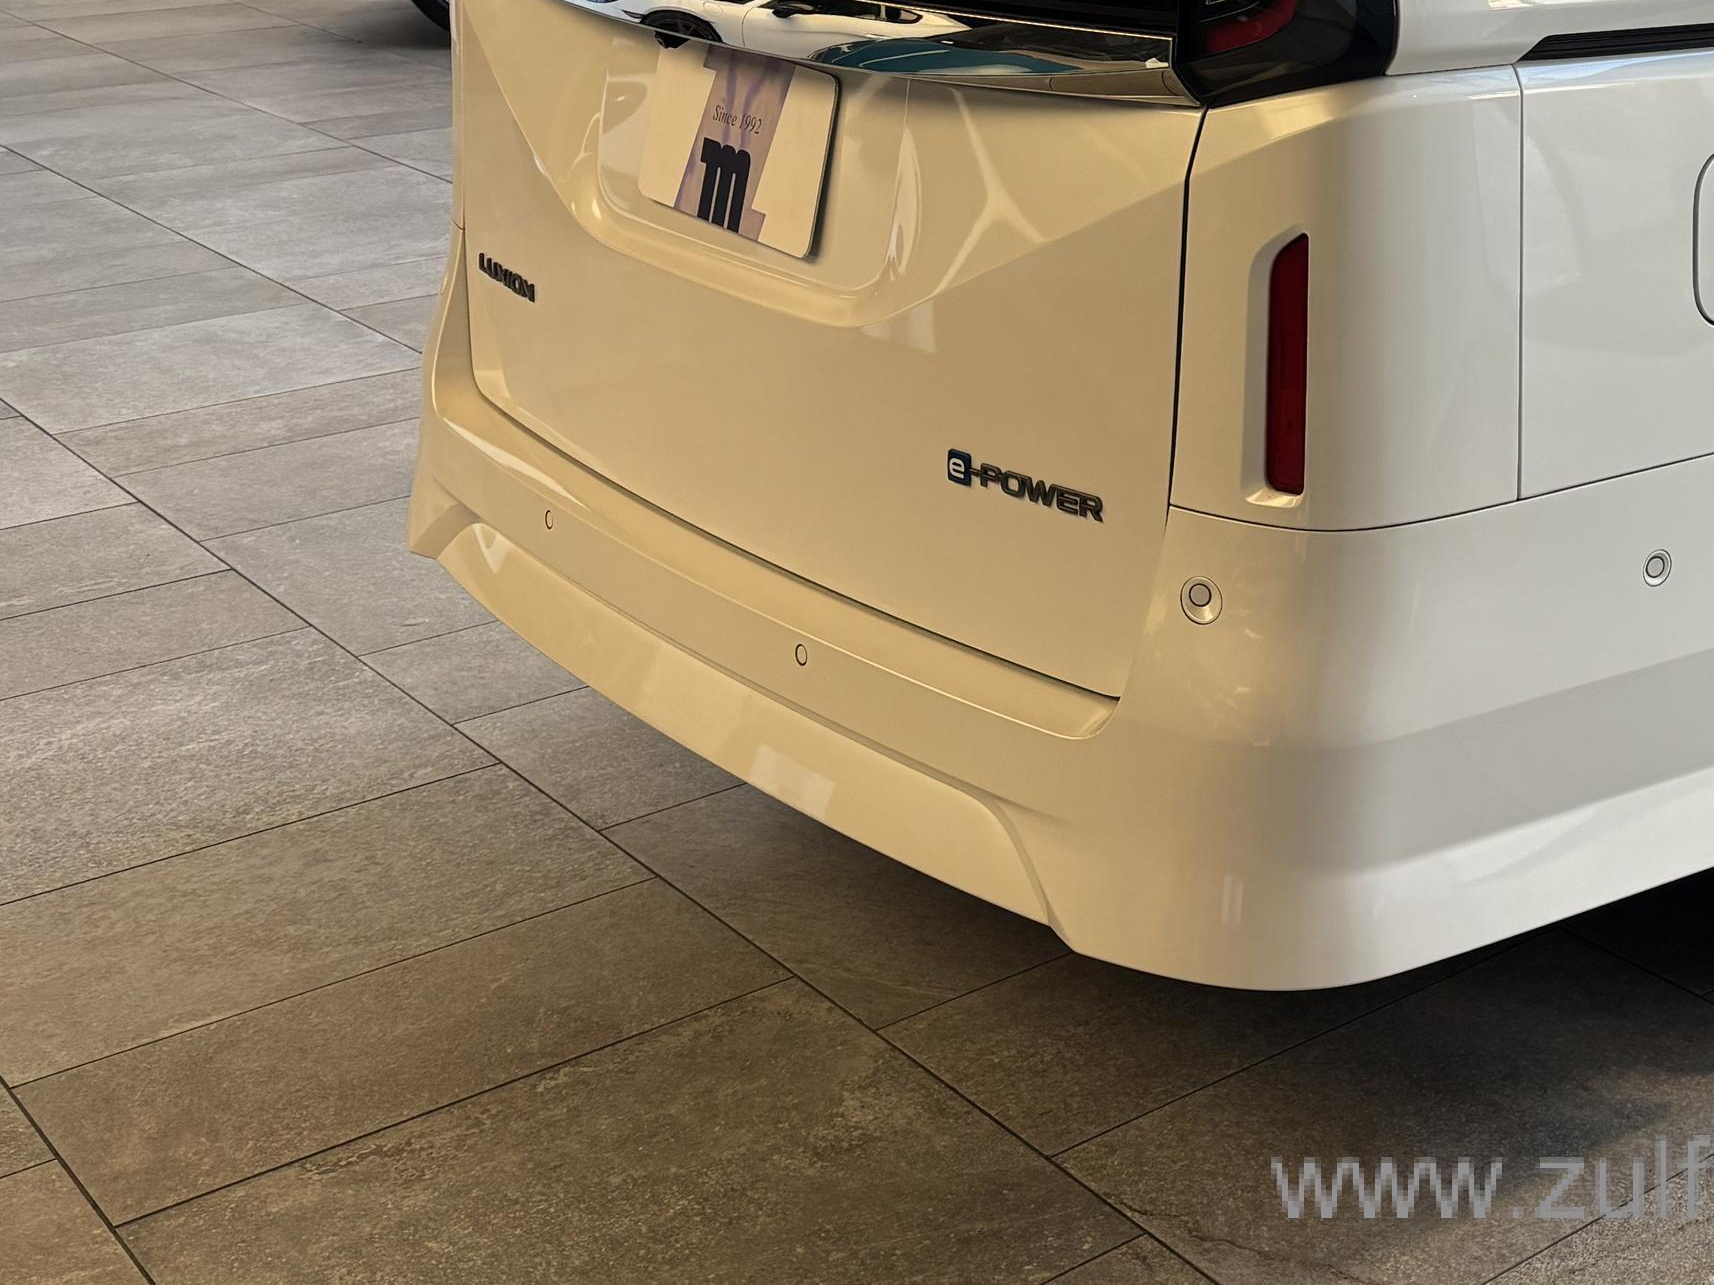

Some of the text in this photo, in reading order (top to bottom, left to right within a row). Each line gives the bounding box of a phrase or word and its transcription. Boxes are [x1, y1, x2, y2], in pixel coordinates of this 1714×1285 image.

[712, 104, 763, 135] Since 1992
[478, 252, 536, 303] LUXION
[947, 449, 1104, 523] e-POWER
